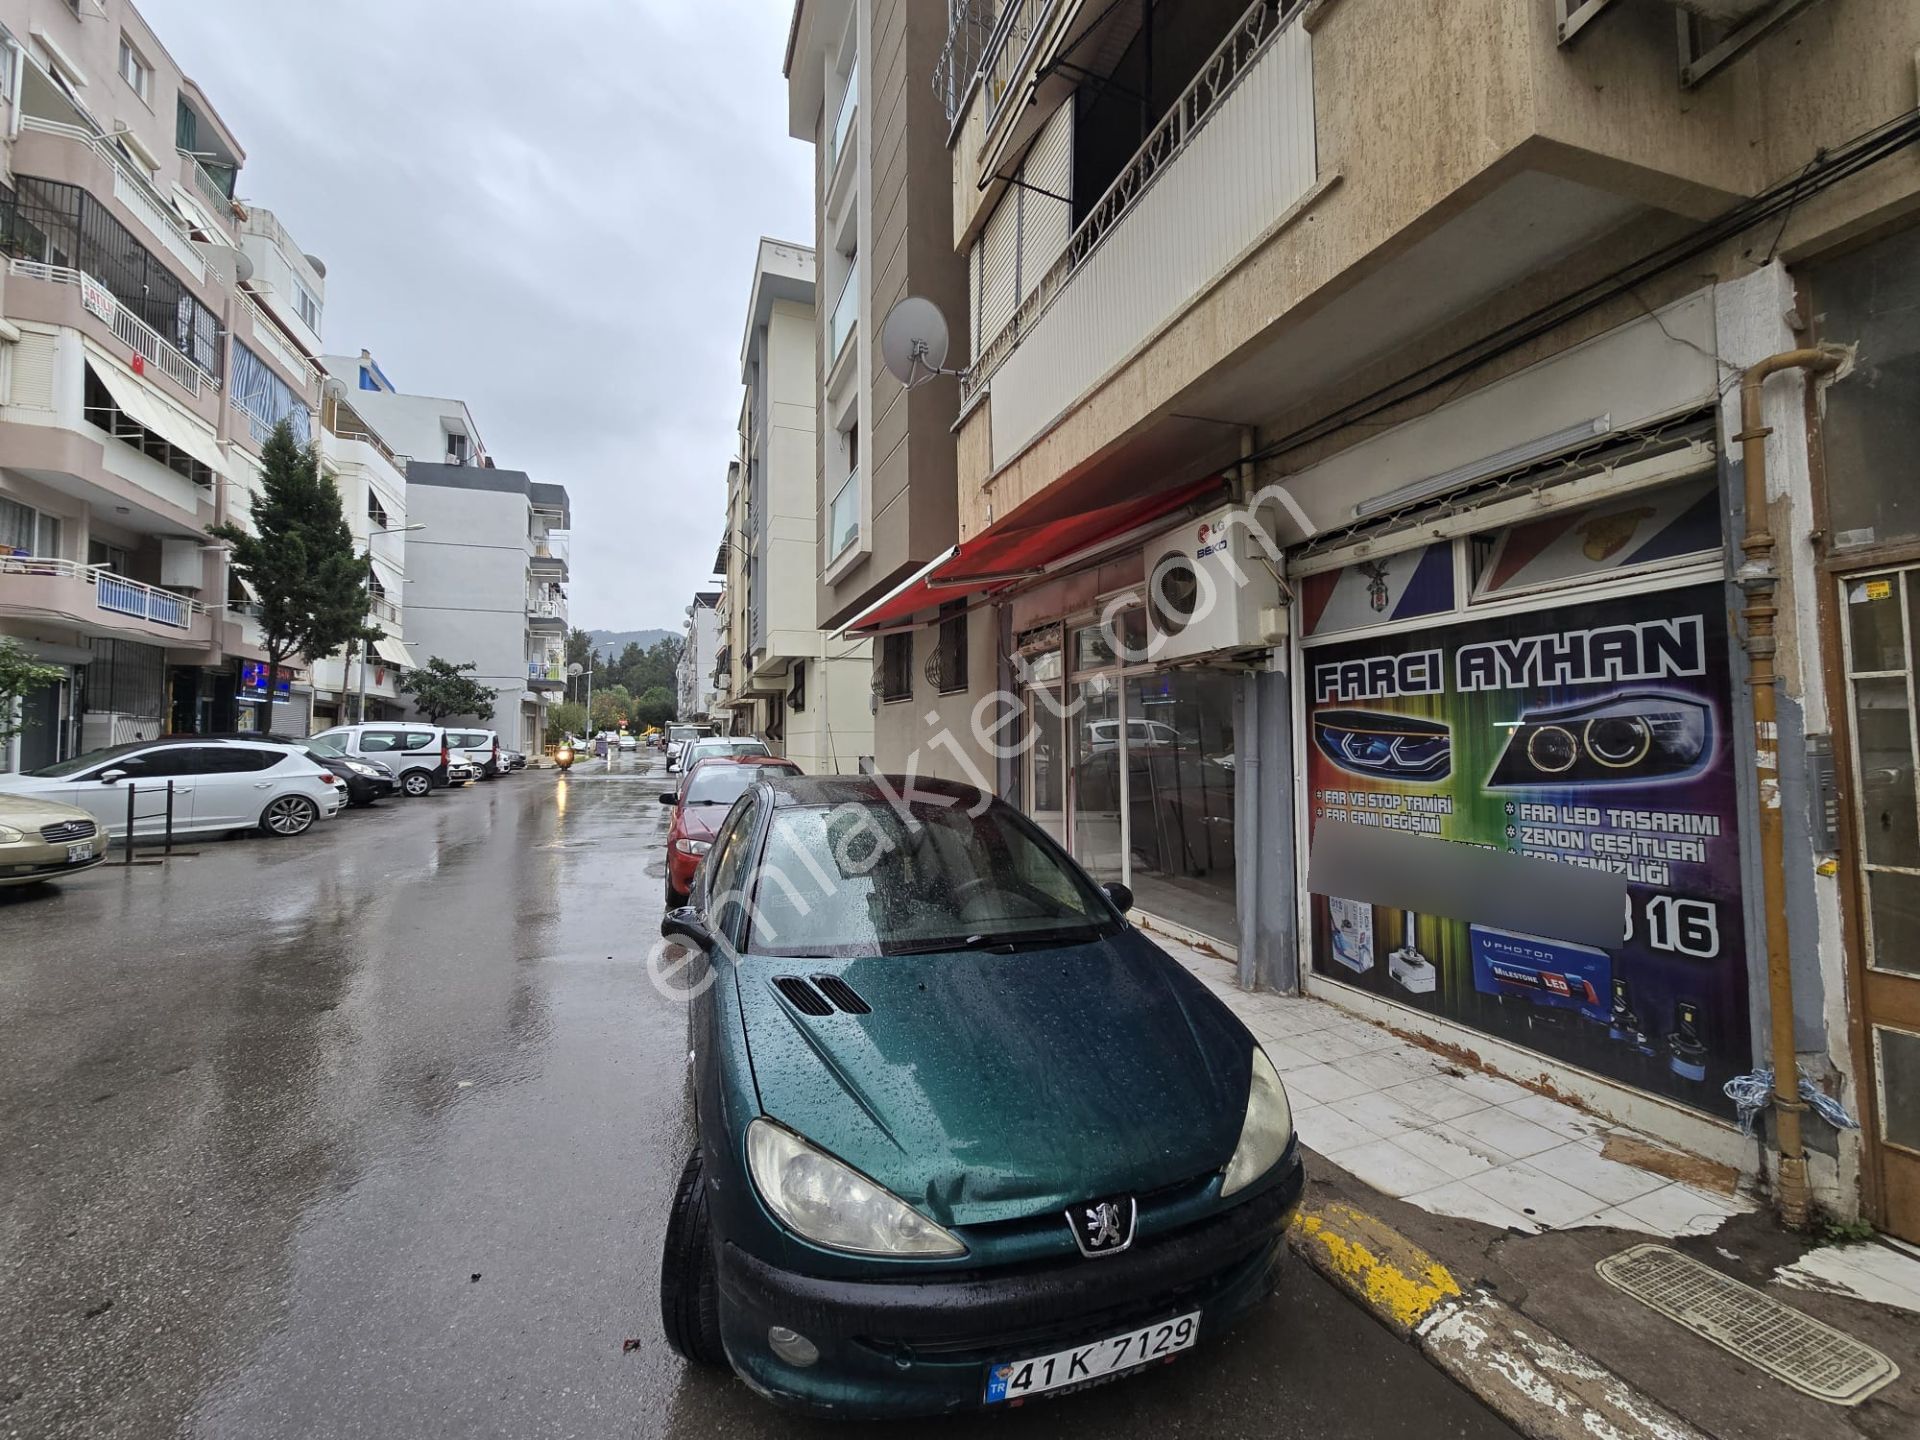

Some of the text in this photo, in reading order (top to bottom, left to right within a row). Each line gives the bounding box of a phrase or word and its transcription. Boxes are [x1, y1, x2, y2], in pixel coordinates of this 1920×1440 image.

[1197, 540, 1227, 559] BEKO
[1315, 614, 1706, 702] FARCI AYHAN
[1325, 791, 1452, 813] FAR VE STOP TAMİRİ
[1520, 804, 1720, 836] FAR LED TASARIMI
[1521, 826, 1706, 863] ZENON ÇEŞİTLERİ
[1542, 976, 1568, 990] LED
[990, 1317, 1193, 1394] TR 41 K 7129
